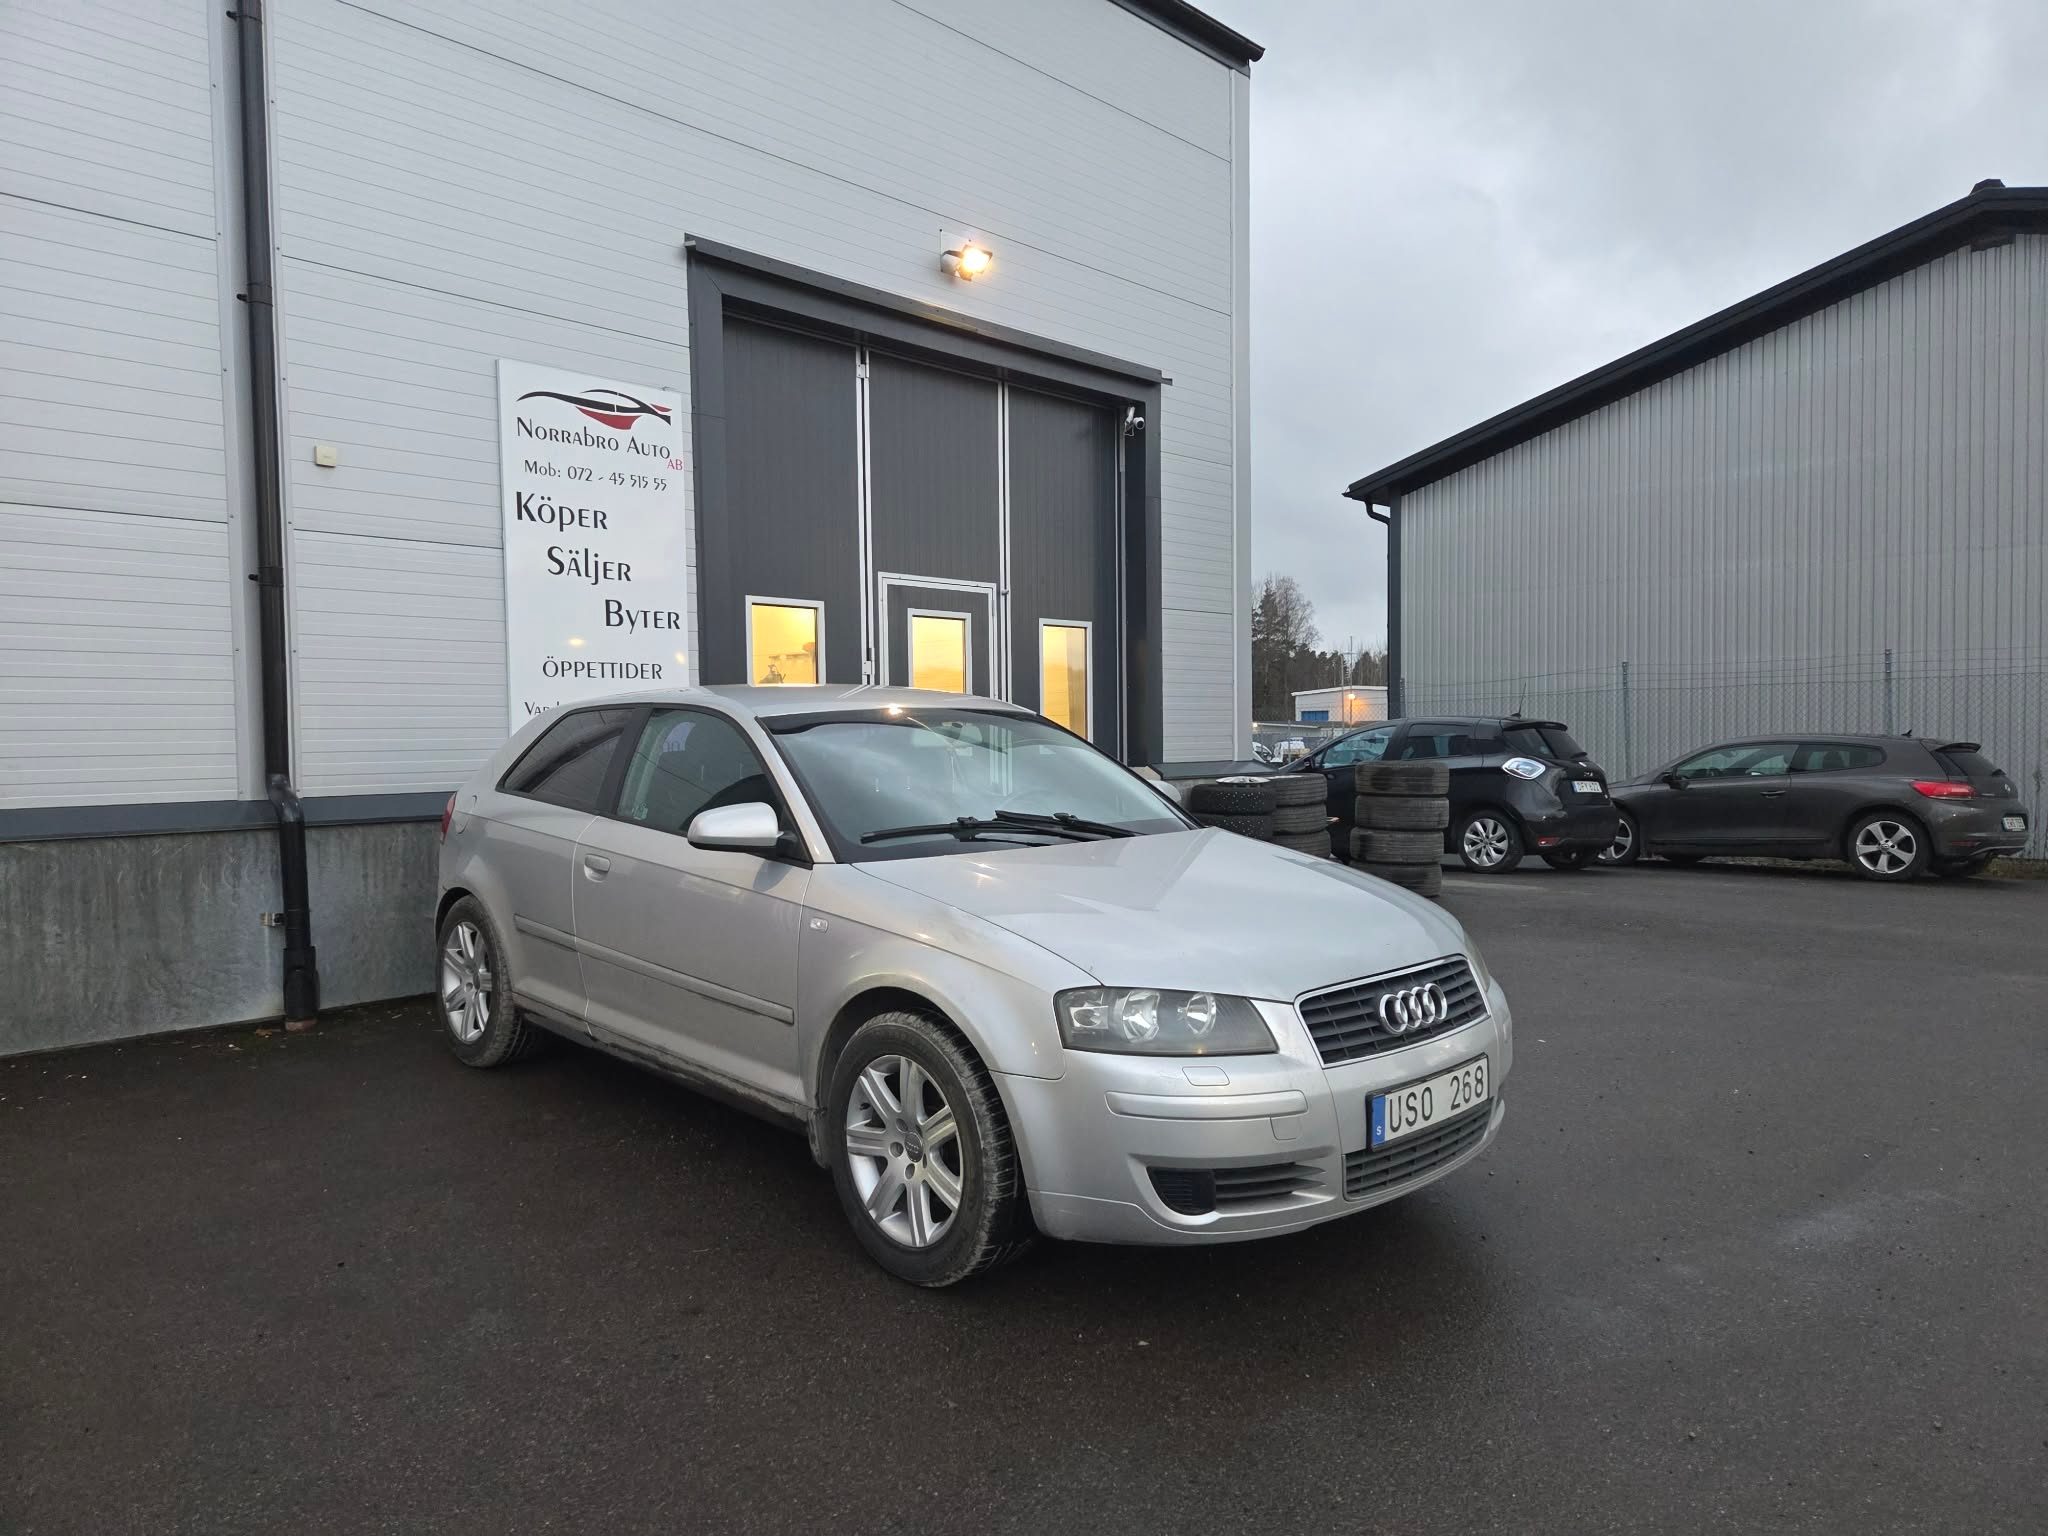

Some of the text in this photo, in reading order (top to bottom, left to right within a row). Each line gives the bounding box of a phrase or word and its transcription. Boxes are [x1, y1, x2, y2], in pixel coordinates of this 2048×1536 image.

[524, 459, 561, 478] Mob:
[567, 466, 593, 482] 072
[609, 472, 625, 486] 45
[630, 474, 649, 489] 515
[653, 477, 667, 491] 55
[667, 458, 683, 471] AB
[542, 655, 663, 680] ÖPPETTIDER
[1389, 1065, 1483, 1133] USO 268
[1376, 1125, 1382, 1136] S
